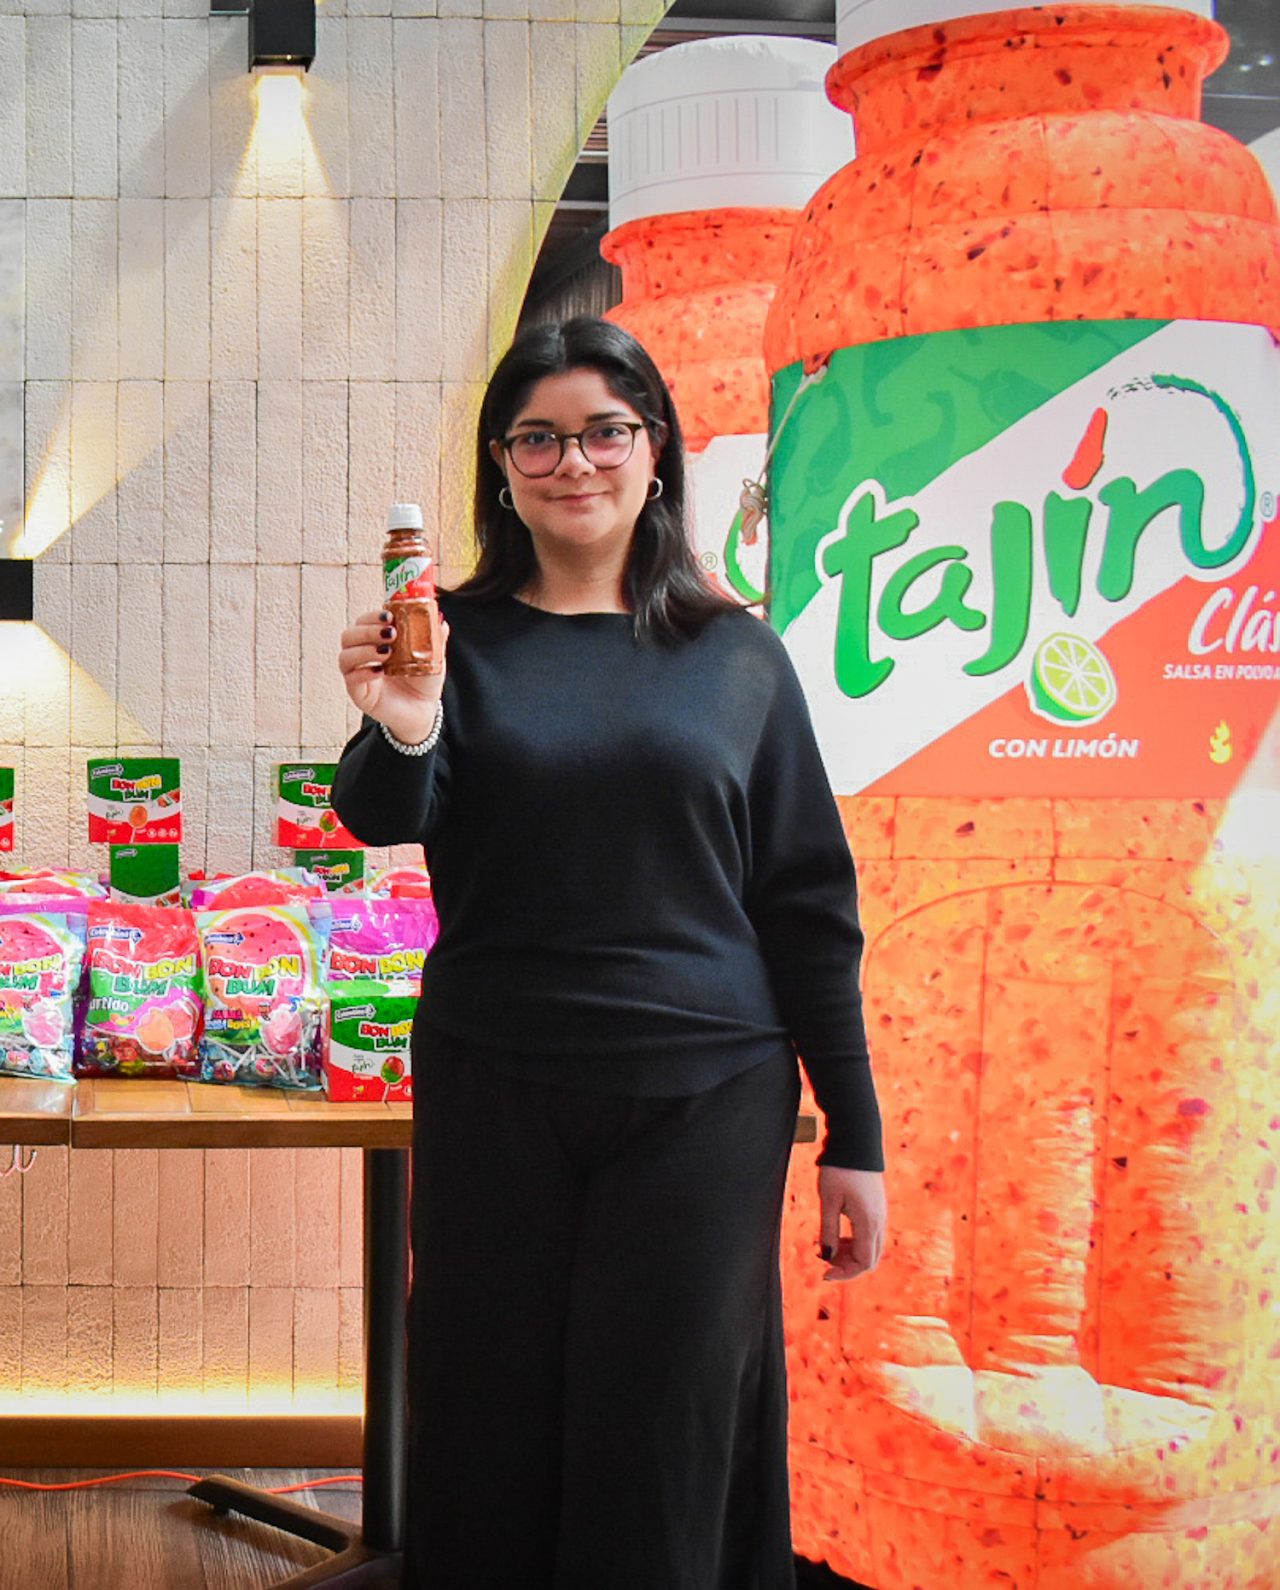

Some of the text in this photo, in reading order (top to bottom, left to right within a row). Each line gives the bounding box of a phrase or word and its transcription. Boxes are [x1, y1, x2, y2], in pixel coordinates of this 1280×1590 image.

[1163, 663, 1212, 679] SALSA
[1215, 664, 1235, 679] EN
[988, 732, 1139, 758] CON LIMÓN
[93, 951, 194, 980] BON BON
[208, 958, 252, 979] BON
[330, 950, 425, 974] BON BON
[114, 976, 168, 996] BUM
[226, 979, 276, 996] BUM
[360, 1022, 389, 1037] BON
